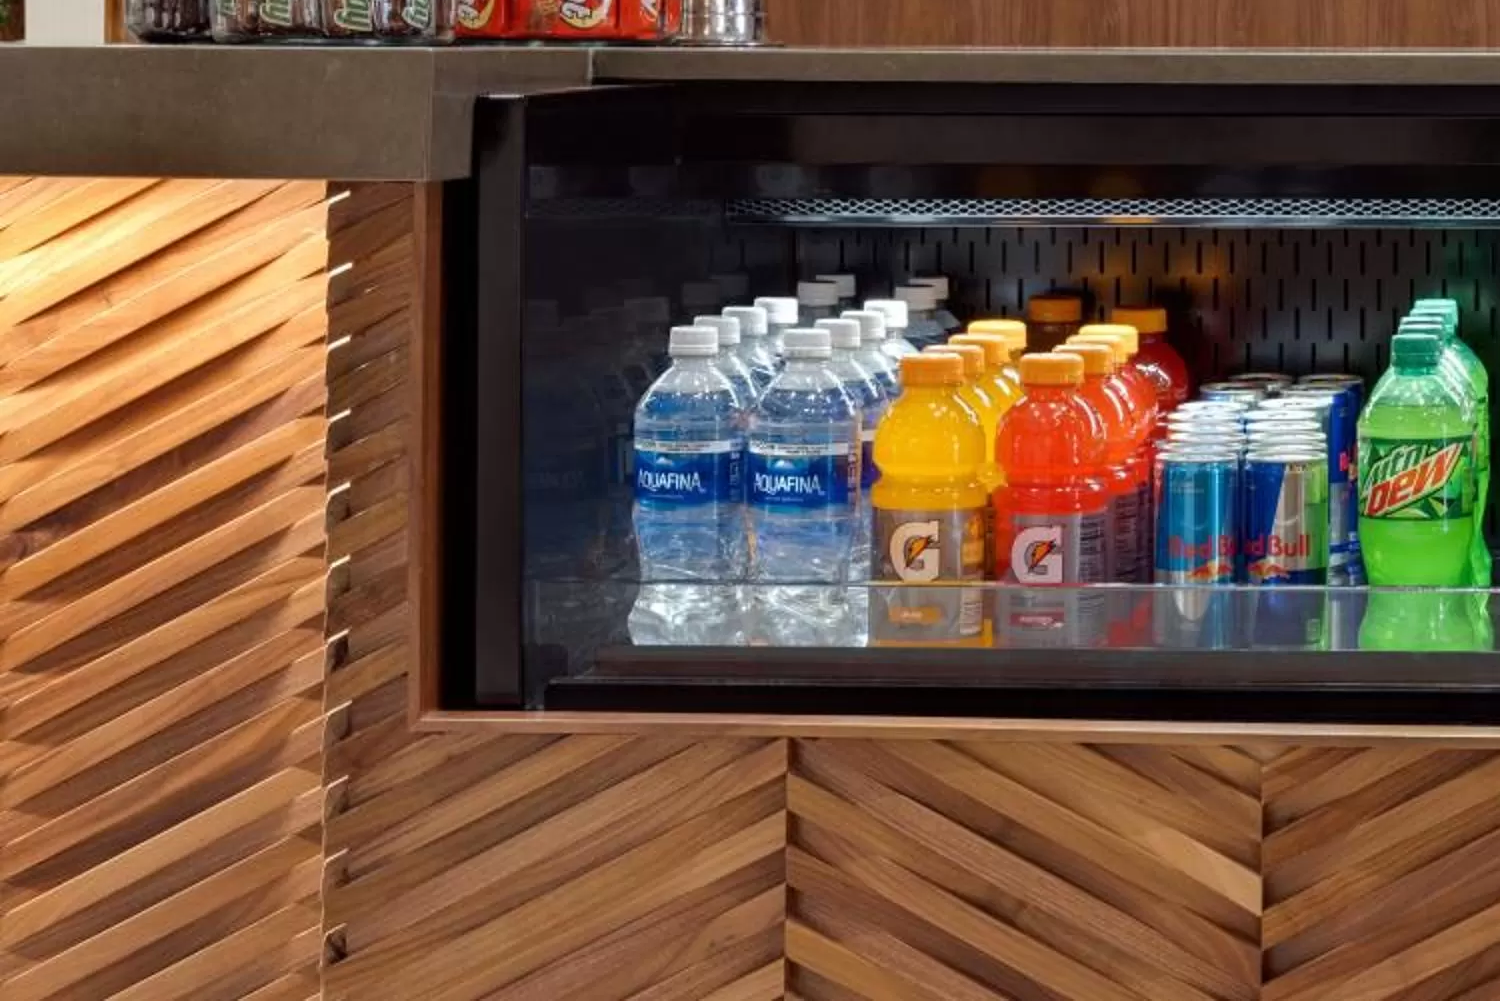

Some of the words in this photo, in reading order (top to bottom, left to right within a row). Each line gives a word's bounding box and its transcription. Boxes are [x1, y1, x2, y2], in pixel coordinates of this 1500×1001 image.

[638, 467, 702, 492] AQUAFINA
[753, 472, 822, 496] AQUAFINA
[890, 519, 940, 583] G
[1011, 525, 1063, 584] G
[1268, 534, 1311, 557] Bull
